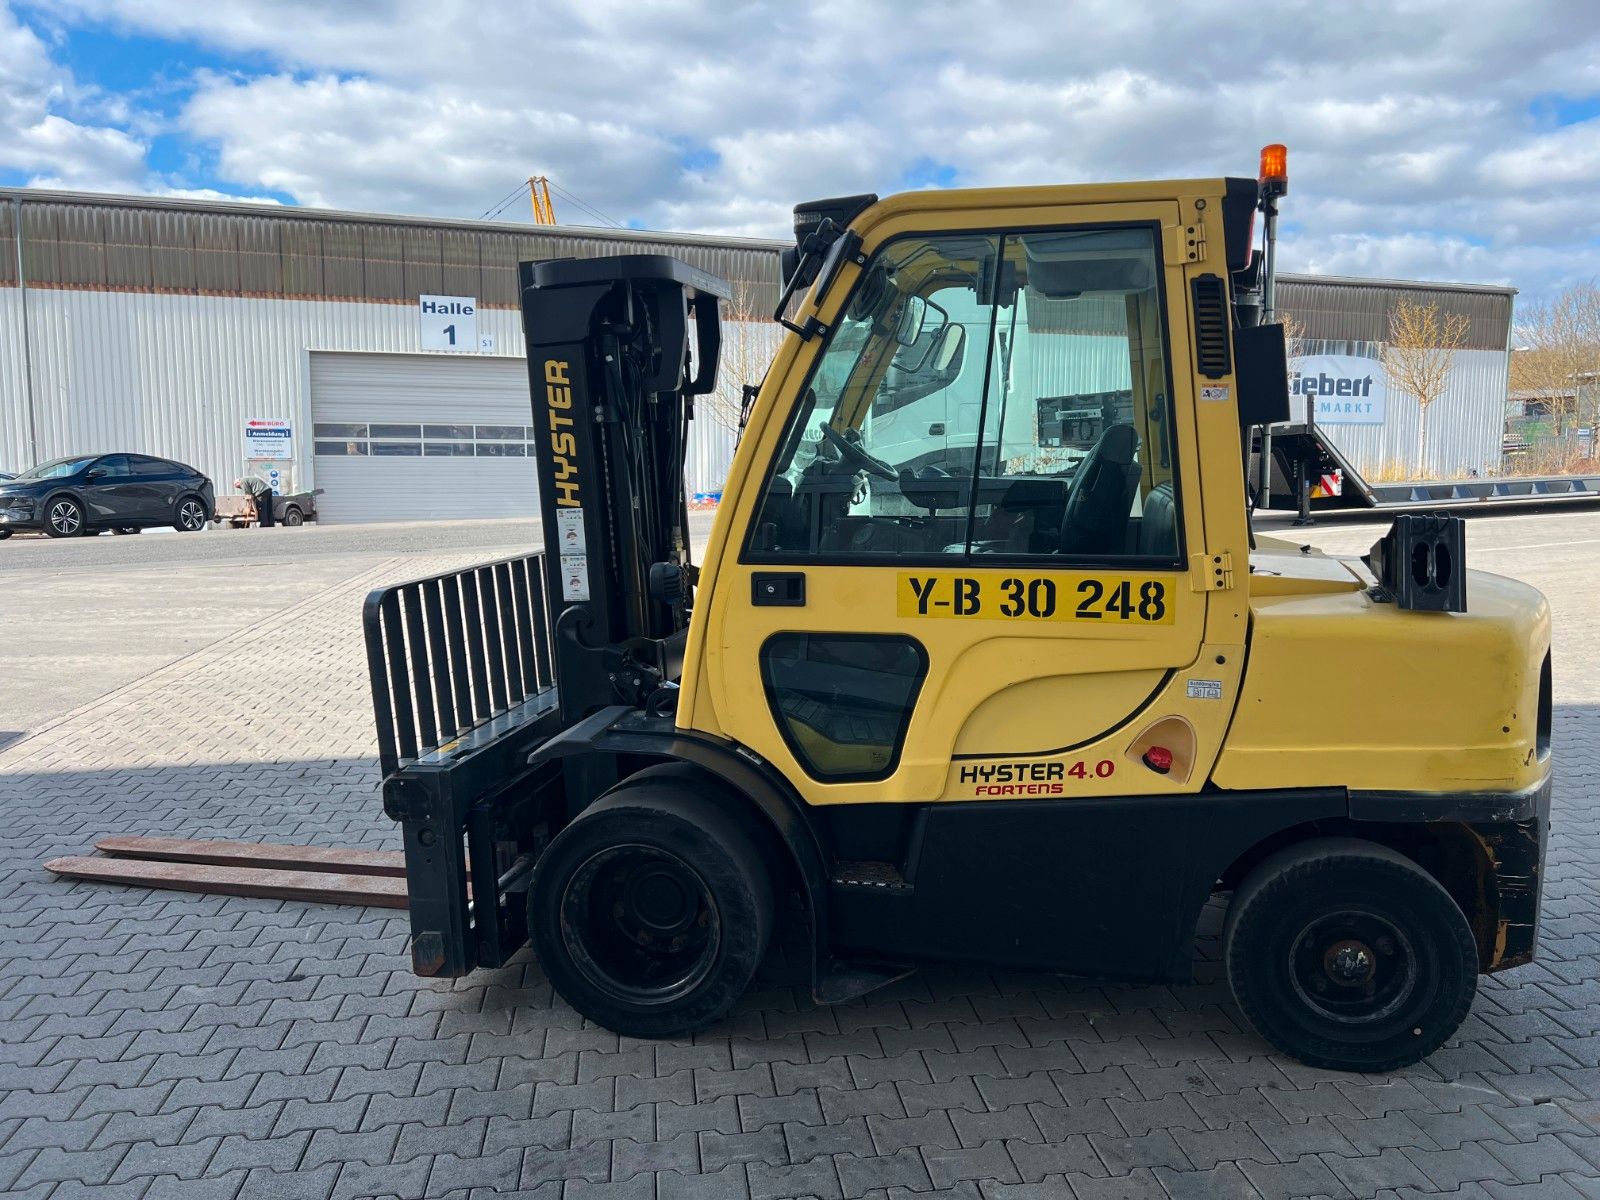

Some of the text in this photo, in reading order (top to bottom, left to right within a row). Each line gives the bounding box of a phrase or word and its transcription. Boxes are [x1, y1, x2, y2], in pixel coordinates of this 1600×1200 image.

[422, 301, 474, 315] Halle
[443, 325, 456, 345] 1
[1287, 372, 1373, 397] iebert
[544, 359, 581, 508] HYSTER
[908, 577, 1166, 621] Y-B 30 248
[960, 760, 1115, 783] HYSTER 4.0
[975, 783, 1064, 796] FORTENS
